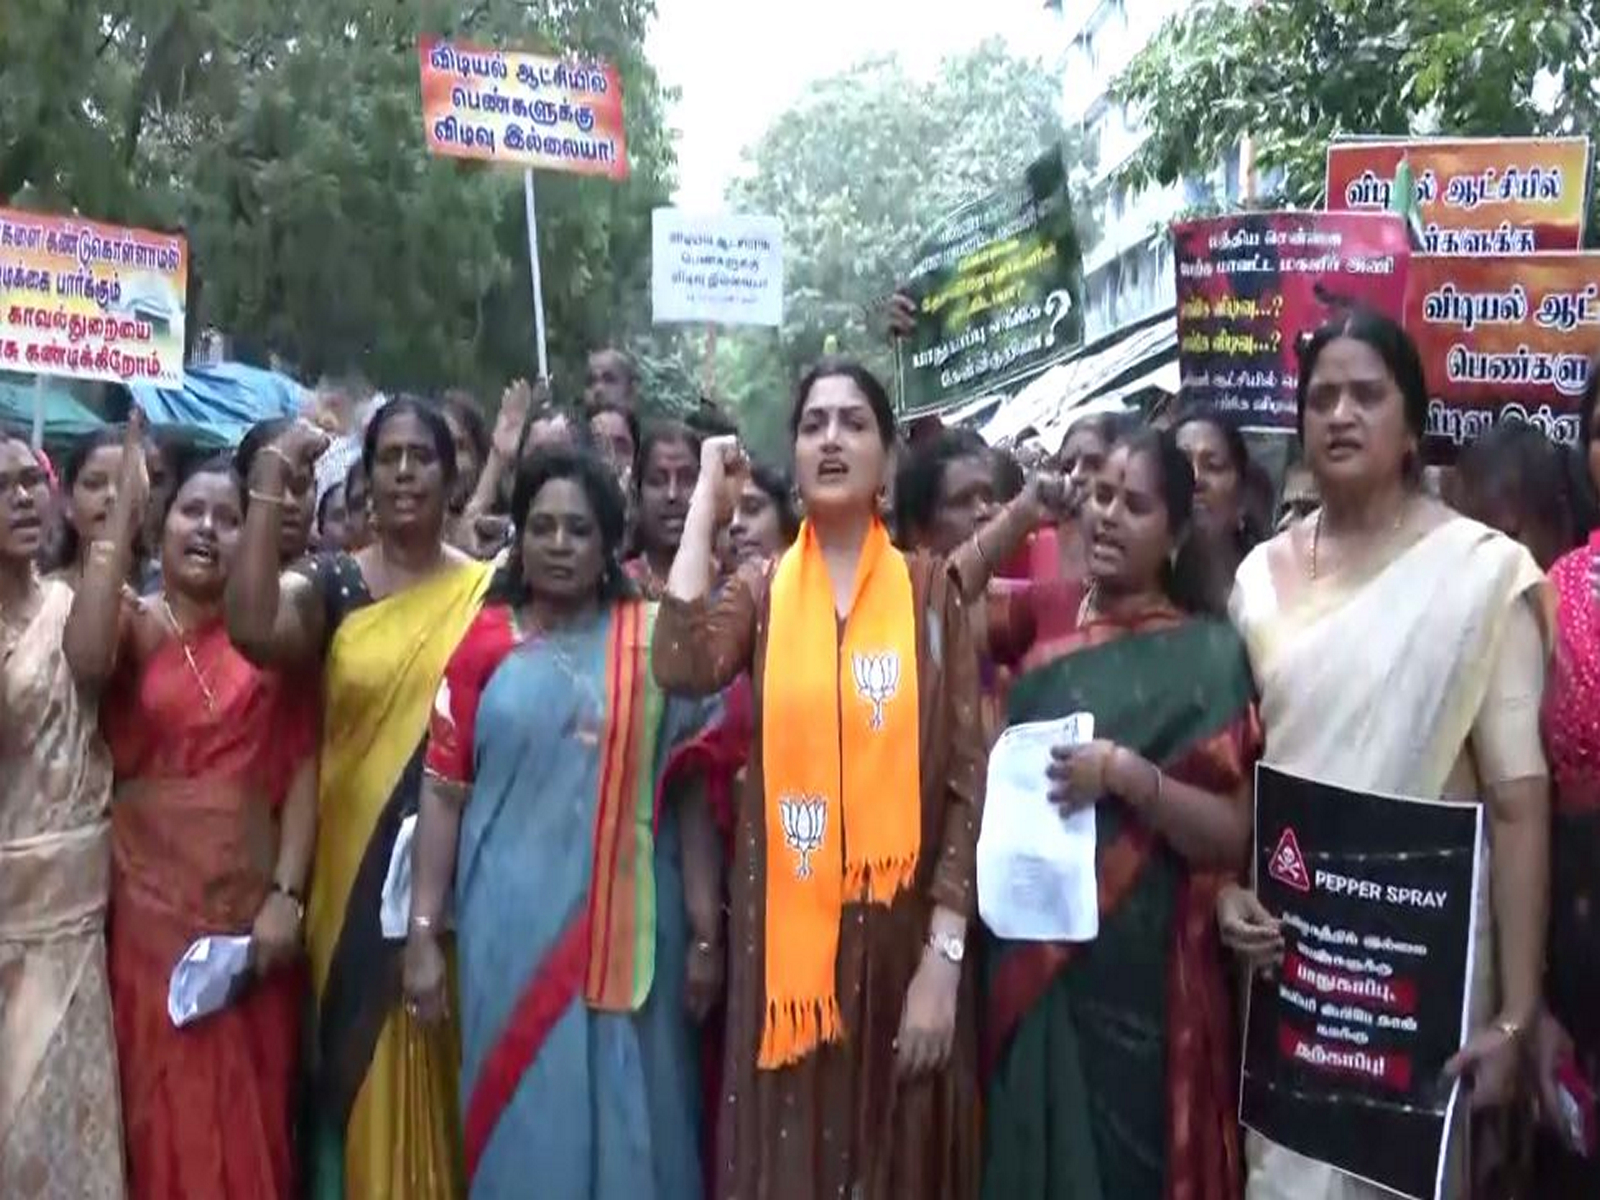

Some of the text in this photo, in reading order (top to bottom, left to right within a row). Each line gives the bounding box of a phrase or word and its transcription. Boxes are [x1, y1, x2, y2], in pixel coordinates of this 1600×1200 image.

[431, 44, 608, 94] விடியல் ஆட்சியில்
[452, 86, 595, 132] பெண்களுக்கு
[435, 116, 616, 164] விடிவு இல்லையா!
[1347, 167, 1562, 211] விடில் ஆட்சியில்
[56, 265, 122, 308] பார்க்கும்
[1424, 284, 1528, 331] விடியல்
[7, 302, 152, 342] காவல்துறையை
[1315, 869, 1448, 909] PEPPER SPRAY
